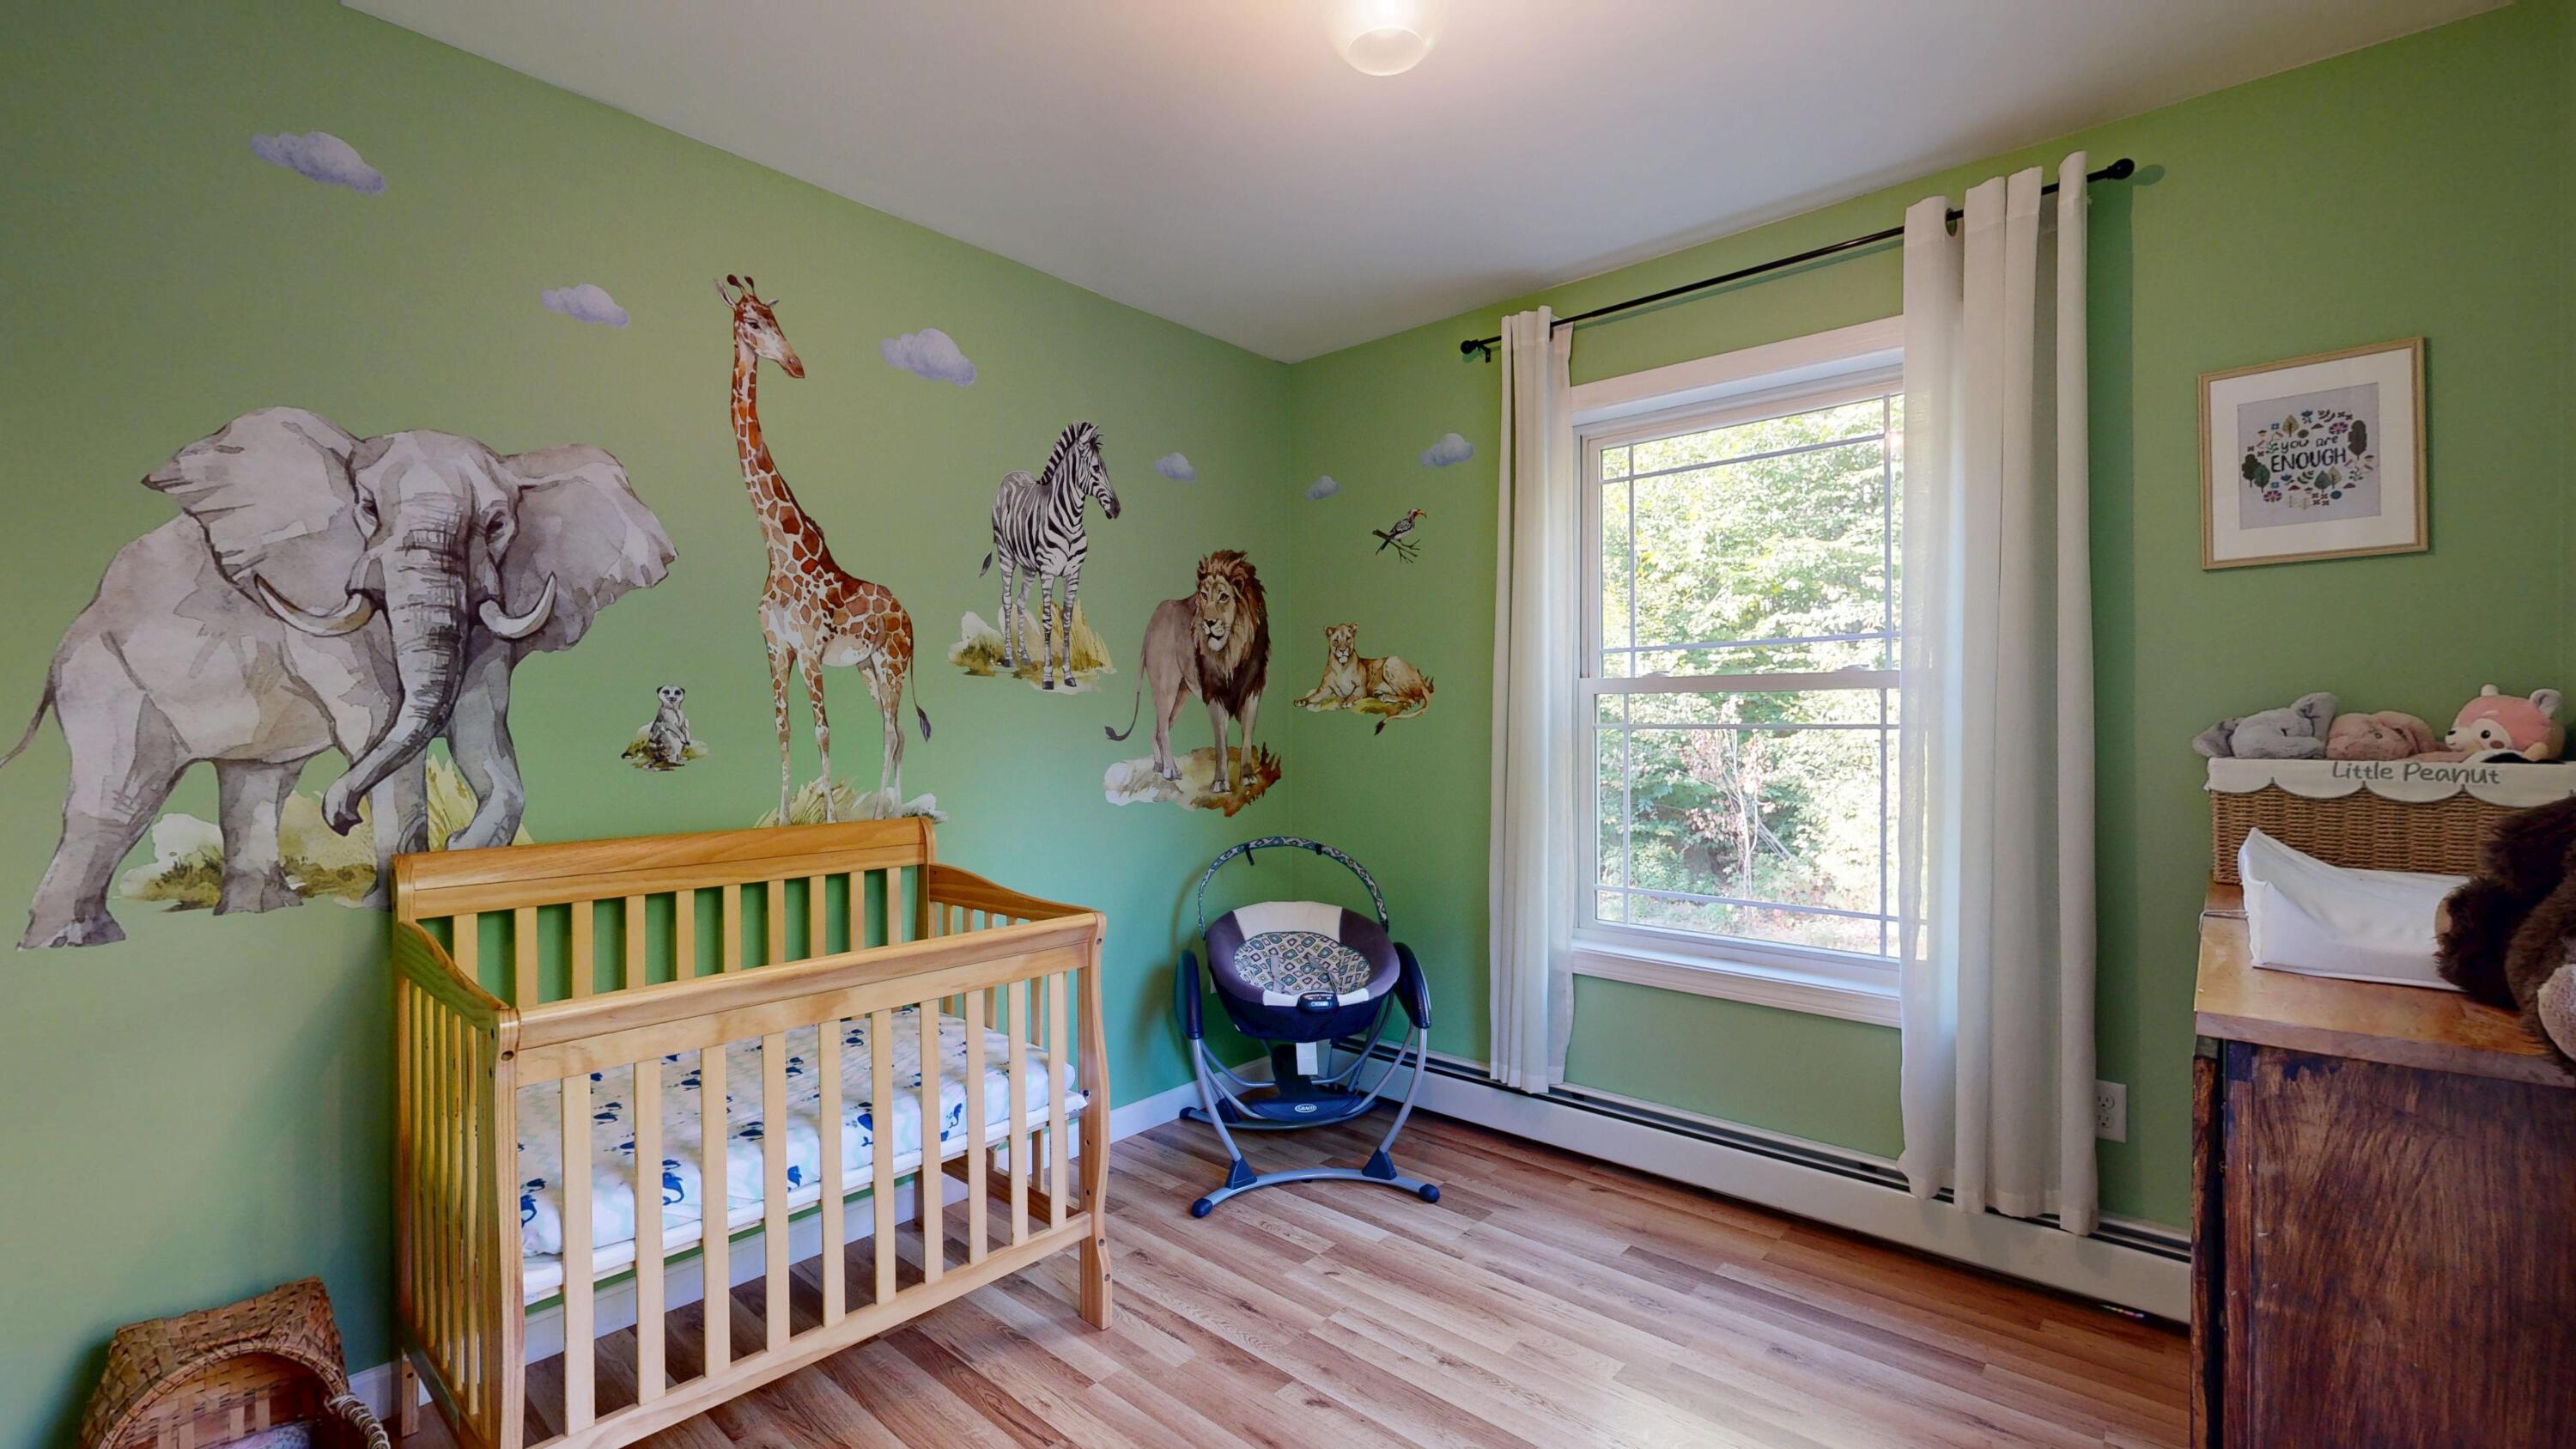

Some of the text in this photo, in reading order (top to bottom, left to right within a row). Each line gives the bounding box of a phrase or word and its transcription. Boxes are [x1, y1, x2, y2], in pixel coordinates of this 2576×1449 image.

[2281, 435, 2338, 454] you are
[2271, 447, 2346, 472] ENOUGH
[2332, 762, 2500, 784] Little Peanut
